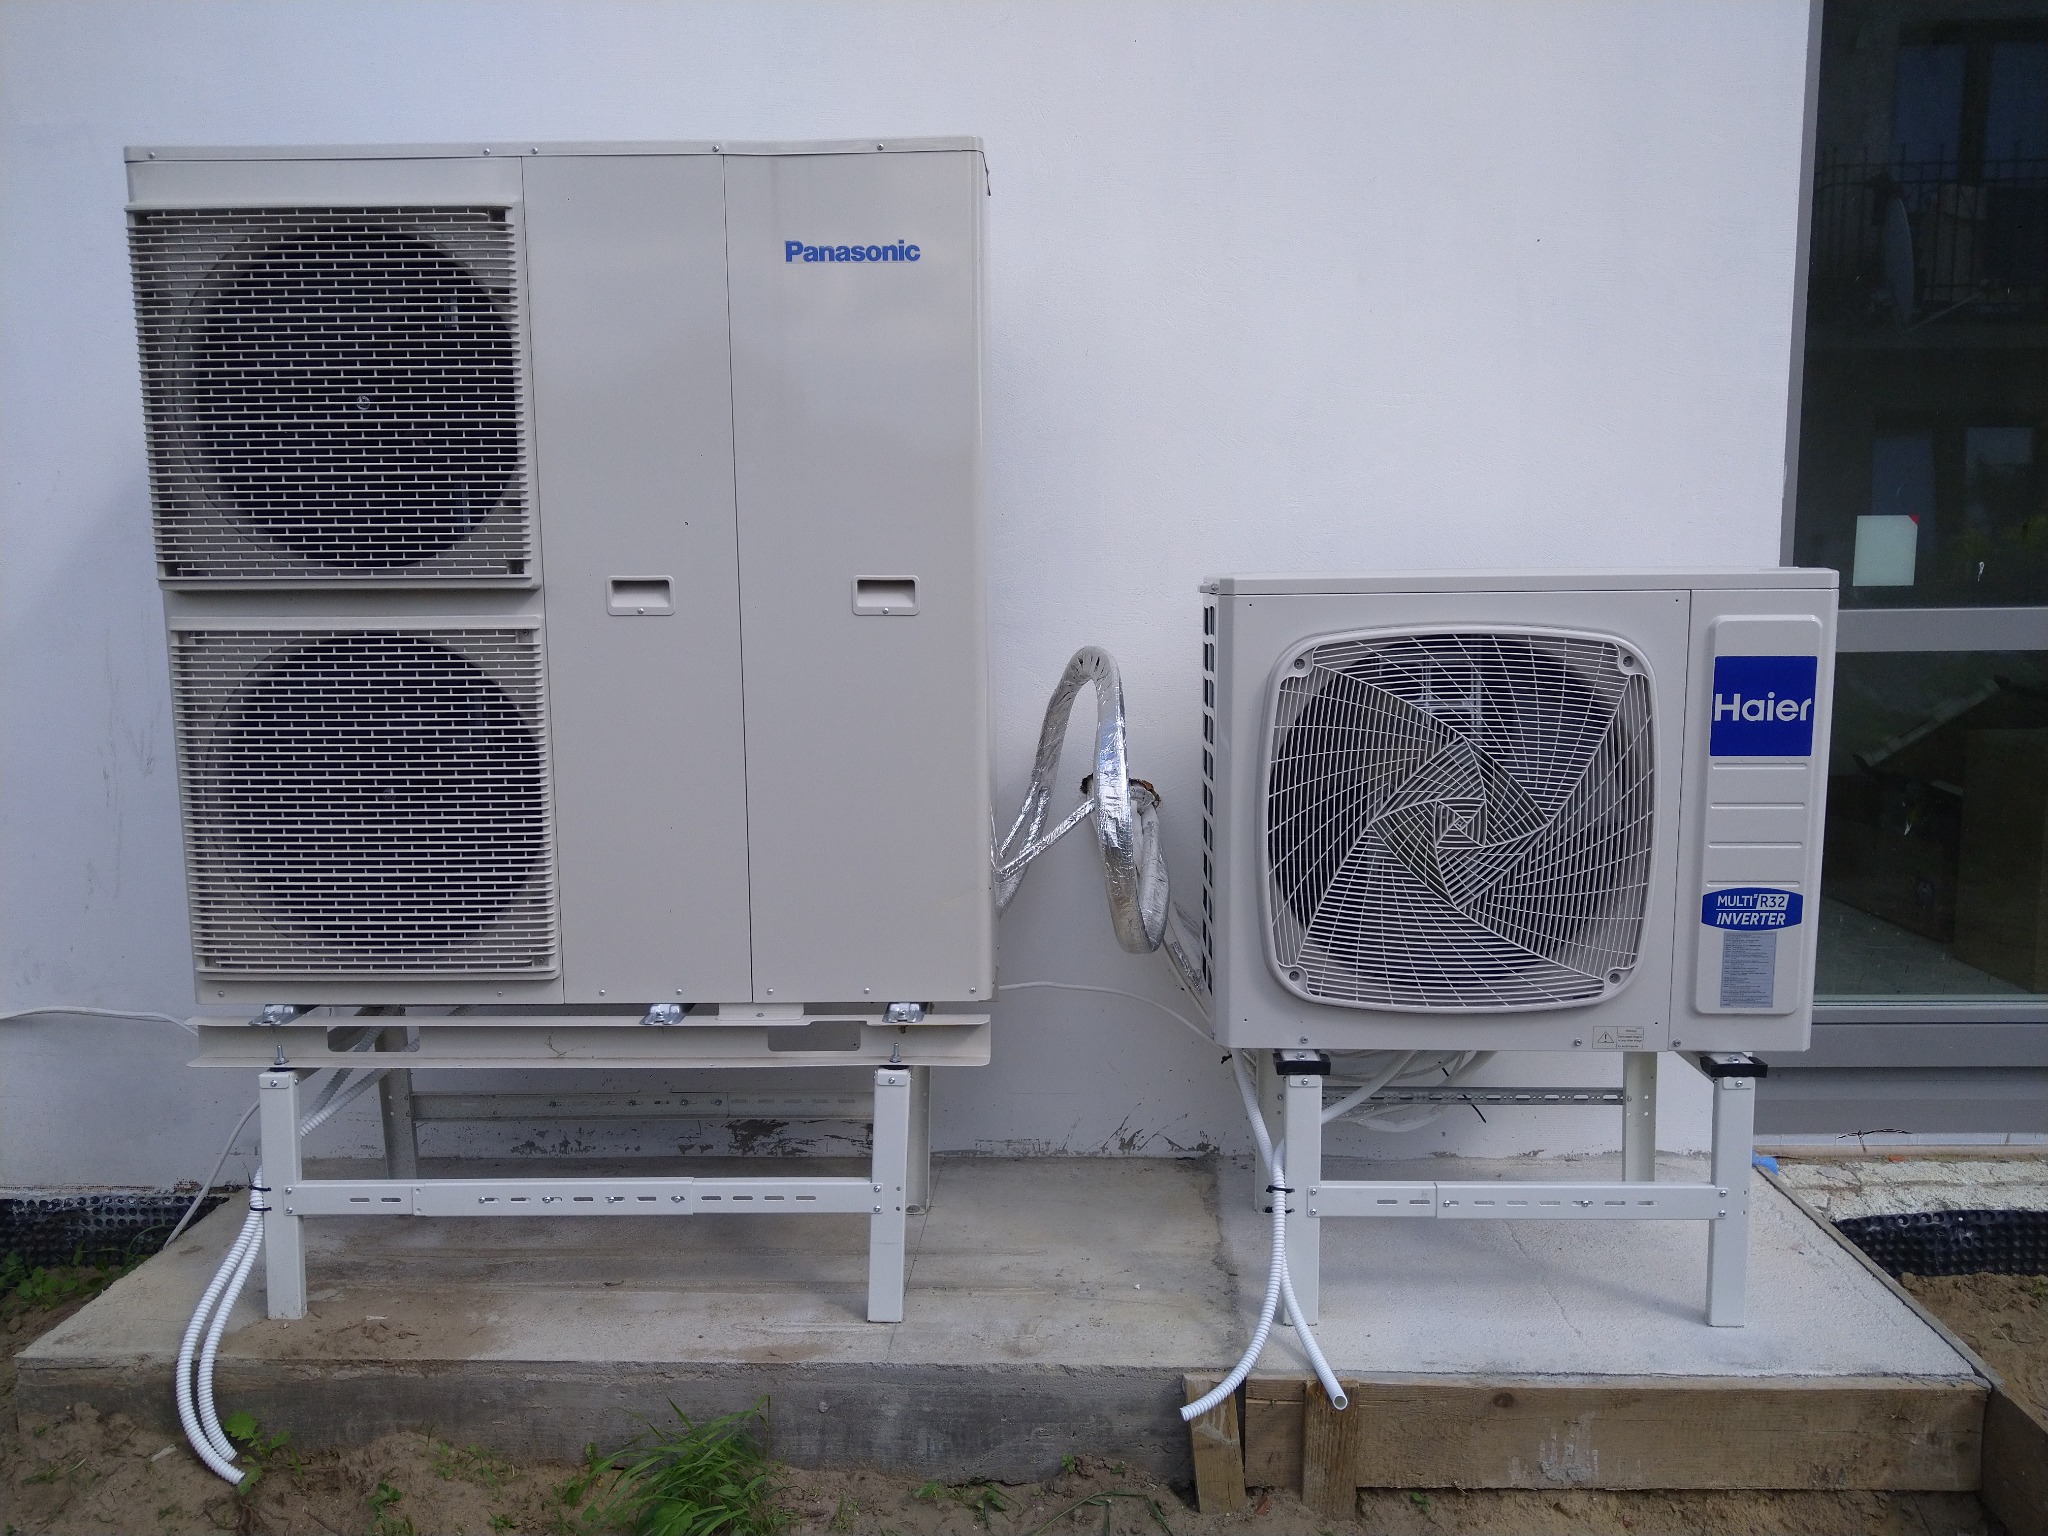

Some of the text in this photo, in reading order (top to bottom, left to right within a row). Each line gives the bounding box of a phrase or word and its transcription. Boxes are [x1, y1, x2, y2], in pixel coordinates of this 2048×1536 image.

[785, 239, 921, 262] Panasonic
[1714, 691, 1812, 722] Haier
[1760, 895, 1785, 908] R32
[1716, 912, 1786, 925] INVERTER
